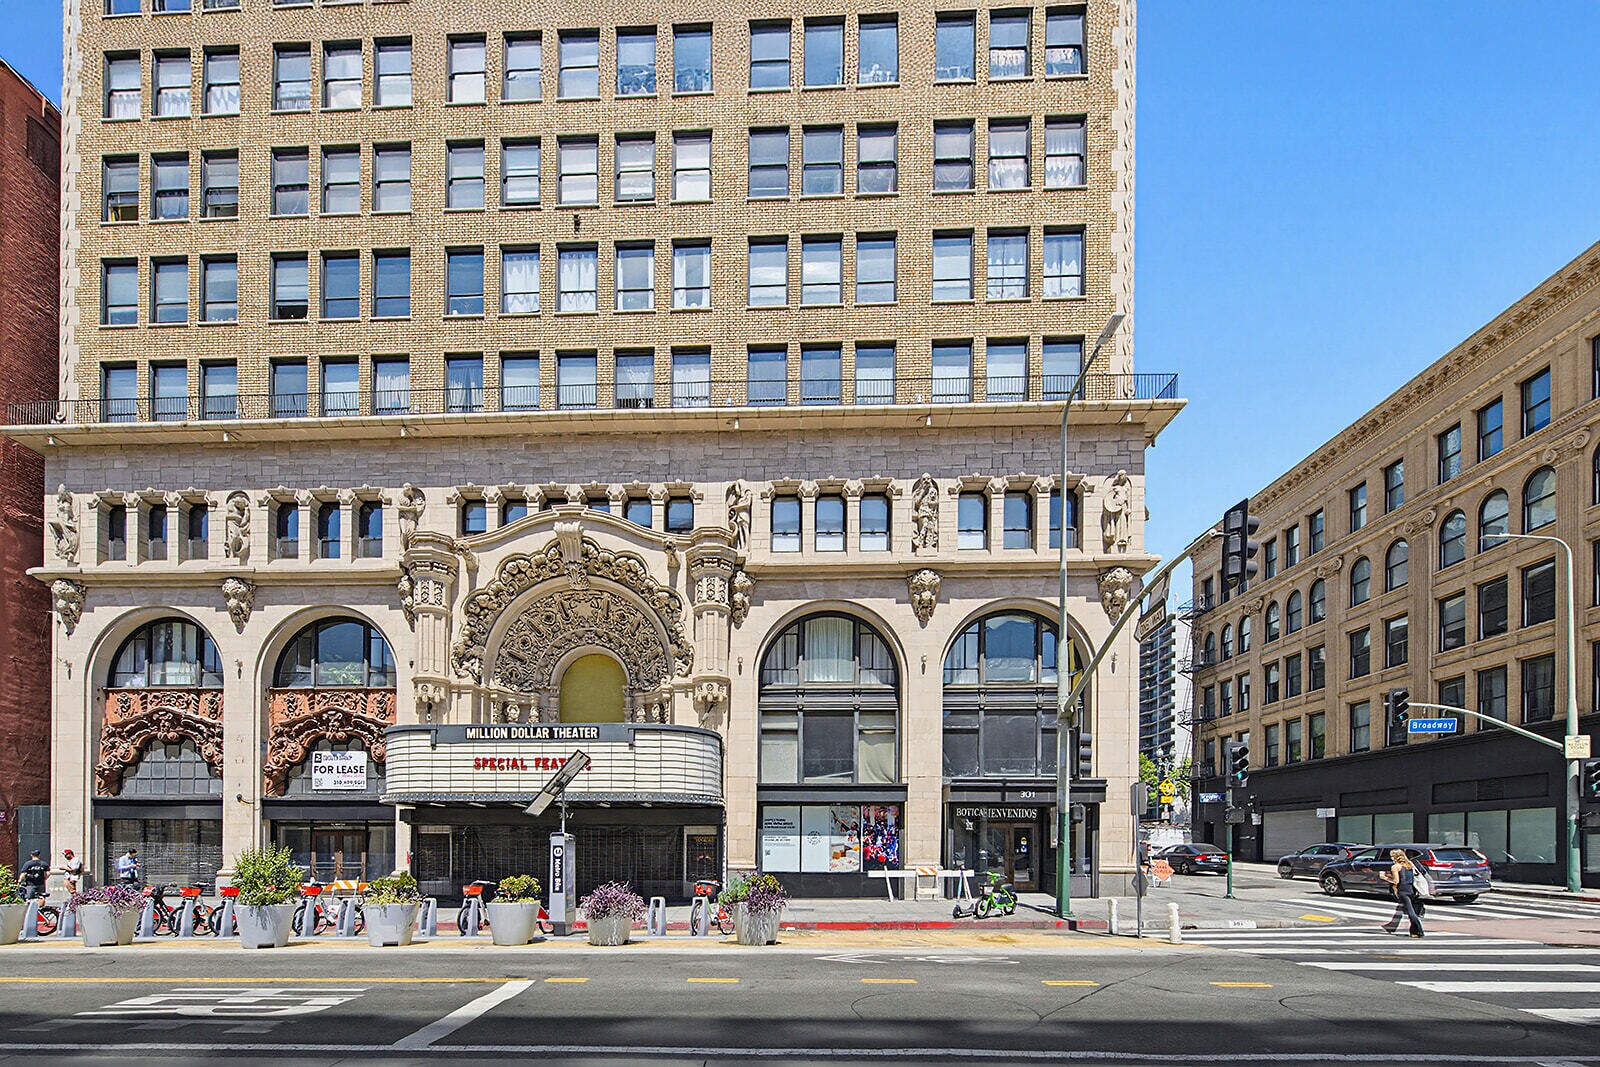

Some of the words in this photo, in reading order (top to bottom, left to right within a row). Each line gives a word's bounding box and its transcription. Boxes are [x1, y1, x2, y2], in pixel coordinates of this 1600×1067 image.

[466, 727, 508, 739] MILLION
[511, 727, 549, 739] DOLLAR
[552, 727, 598, 739] THEATER
[314, 765, 334, 774] FOR
[336, 765, 365, 774] LEASE
[473, 757, 527, 771] SPECIAL
